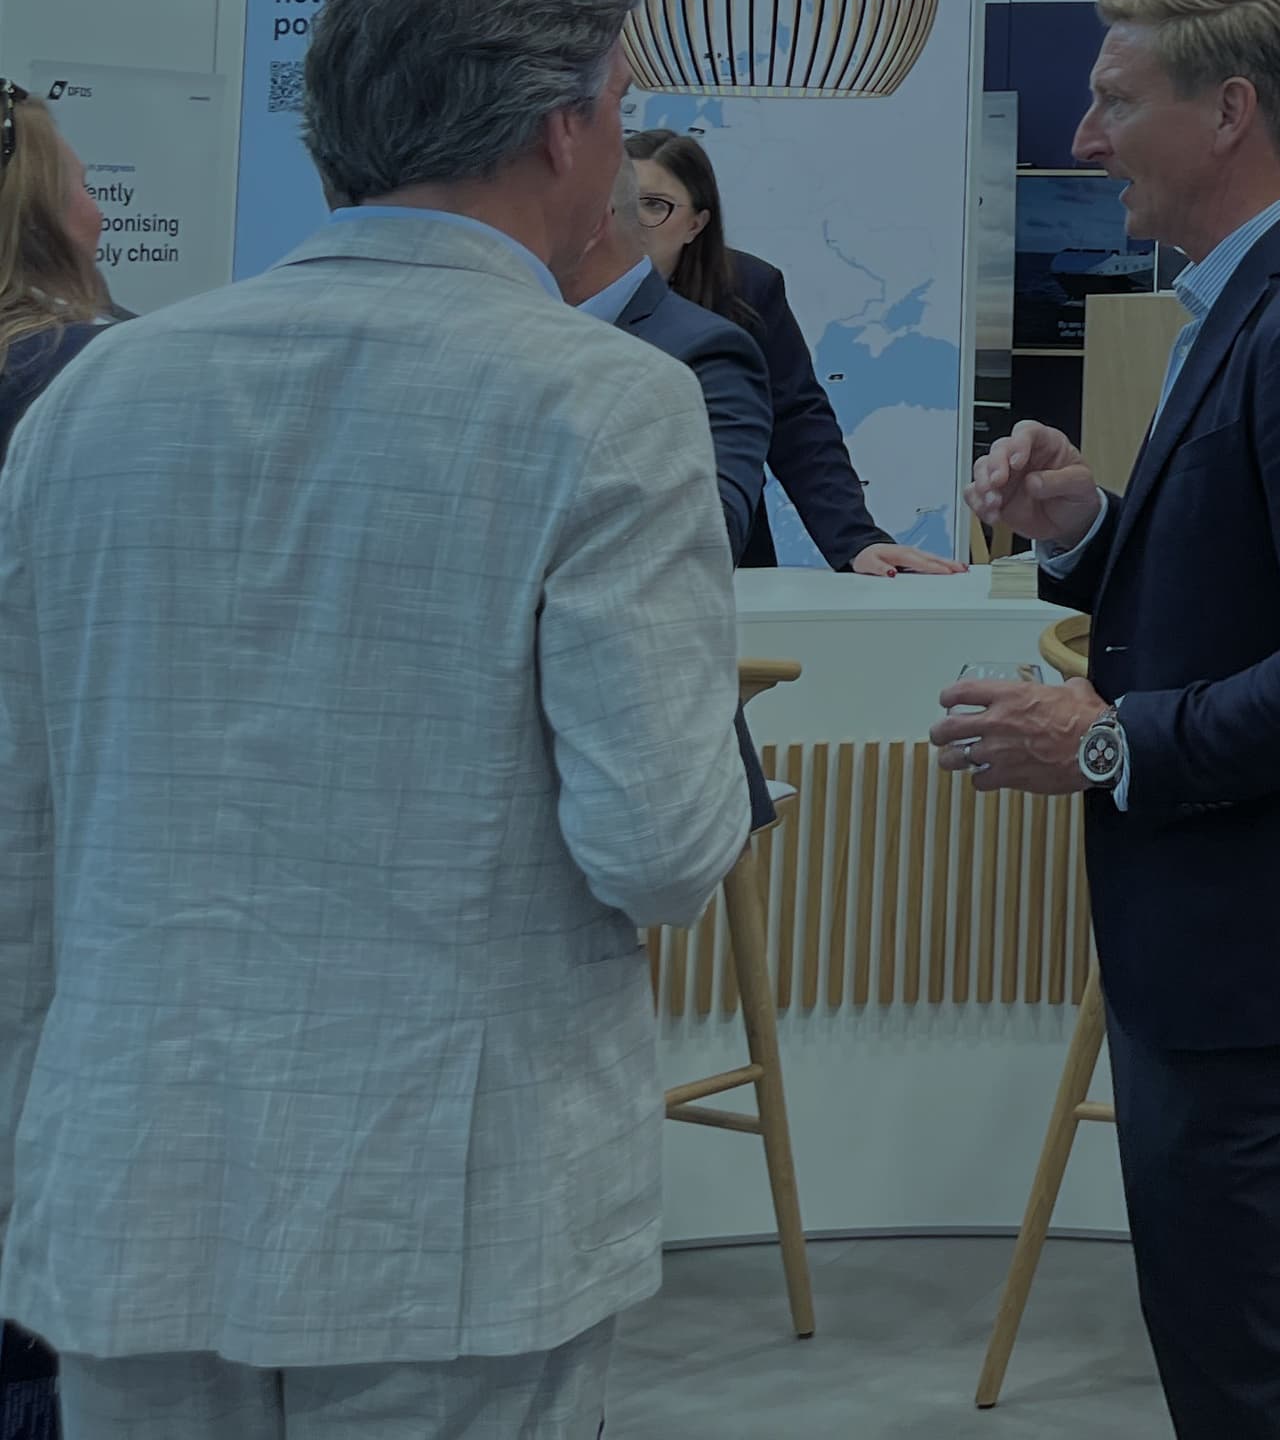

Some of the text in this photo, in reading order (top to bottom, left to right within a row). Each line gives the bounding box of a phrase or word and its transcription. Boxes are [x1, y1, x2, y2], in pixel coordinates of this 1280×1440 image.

[83, 183, 135, 206] ently
[100, 212, 179, 237] bonising
[127, 243, 179, 262] chain
